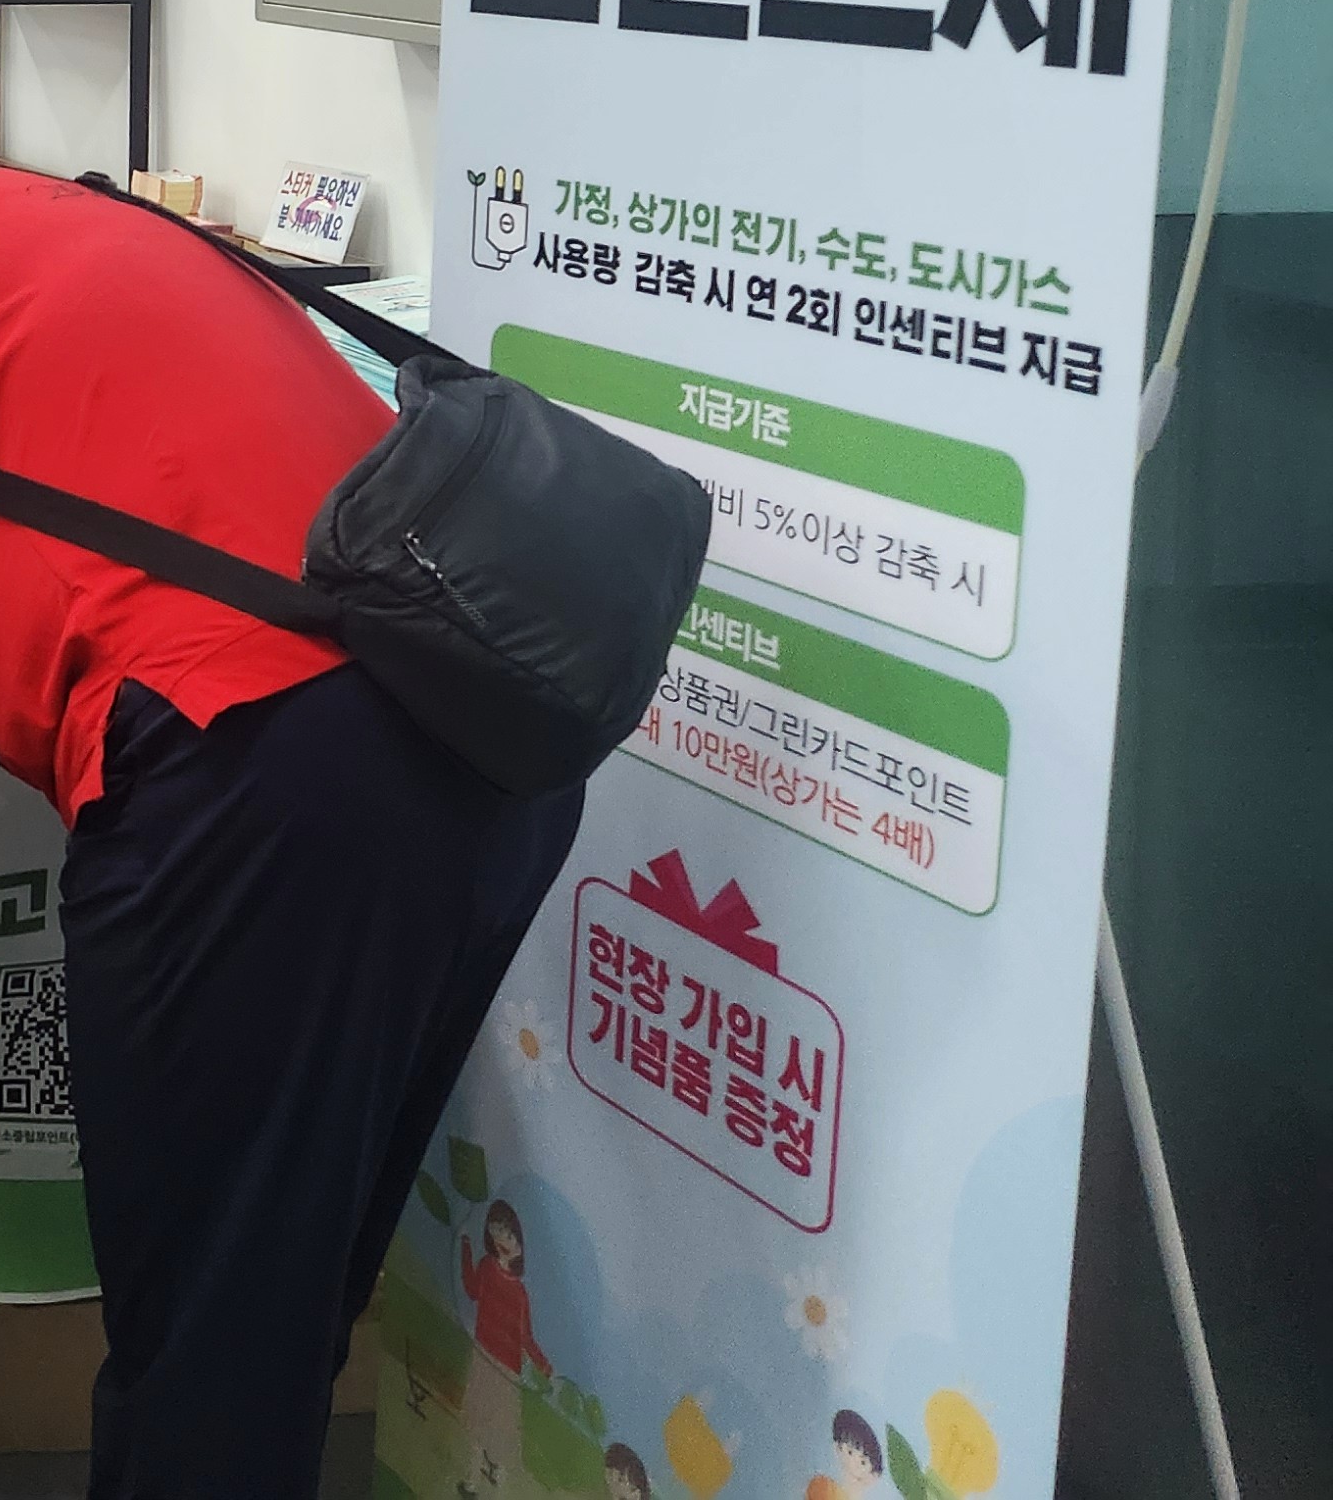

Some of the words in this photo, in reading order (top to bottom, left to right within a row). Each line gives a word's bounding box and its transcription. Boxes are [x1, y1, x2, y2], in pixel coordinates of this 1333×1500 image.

[281, 170, 315, 197] 스티커
[555, 179, 620, 229] 가정,
[628, 191, 721, 248] 상가의
[731, 209, 808, 265] 전기,
[816, 226, 898, 284] 수도,
[908, 241, 1074, 317] 도시가스
[533, 231, 622, 286] 사용량
[634, 251, 696, 305] 감축
[705, 267, 735, 314] 시
[746, 274, 778, 322] 연
[787, 283, 842, 337] 2회
[855, 297, 1007, 375] 인센티브
[1019, 331, 1104, 397] 지급
[679, 382, 792, 449] 지급기준
[754, 498, 864, 565] 5%이상
[874, 534, 943, 593] 감축
[951, 563, 986, 608] 시
[659, 665, 972, 825] 상품권/그린카드포인트
[672, 719, 862, 839] 10만원(상가는
[871, 811, 936, 871] 4배)
[588, 923, 669, 1017] 현장
[683, 971, 766, 1072] 가입
[779, 1032, 825, 1113] 시
[589, 991, 714, 1117] 기념품
[725, 1074, 813, 1181] 증정
